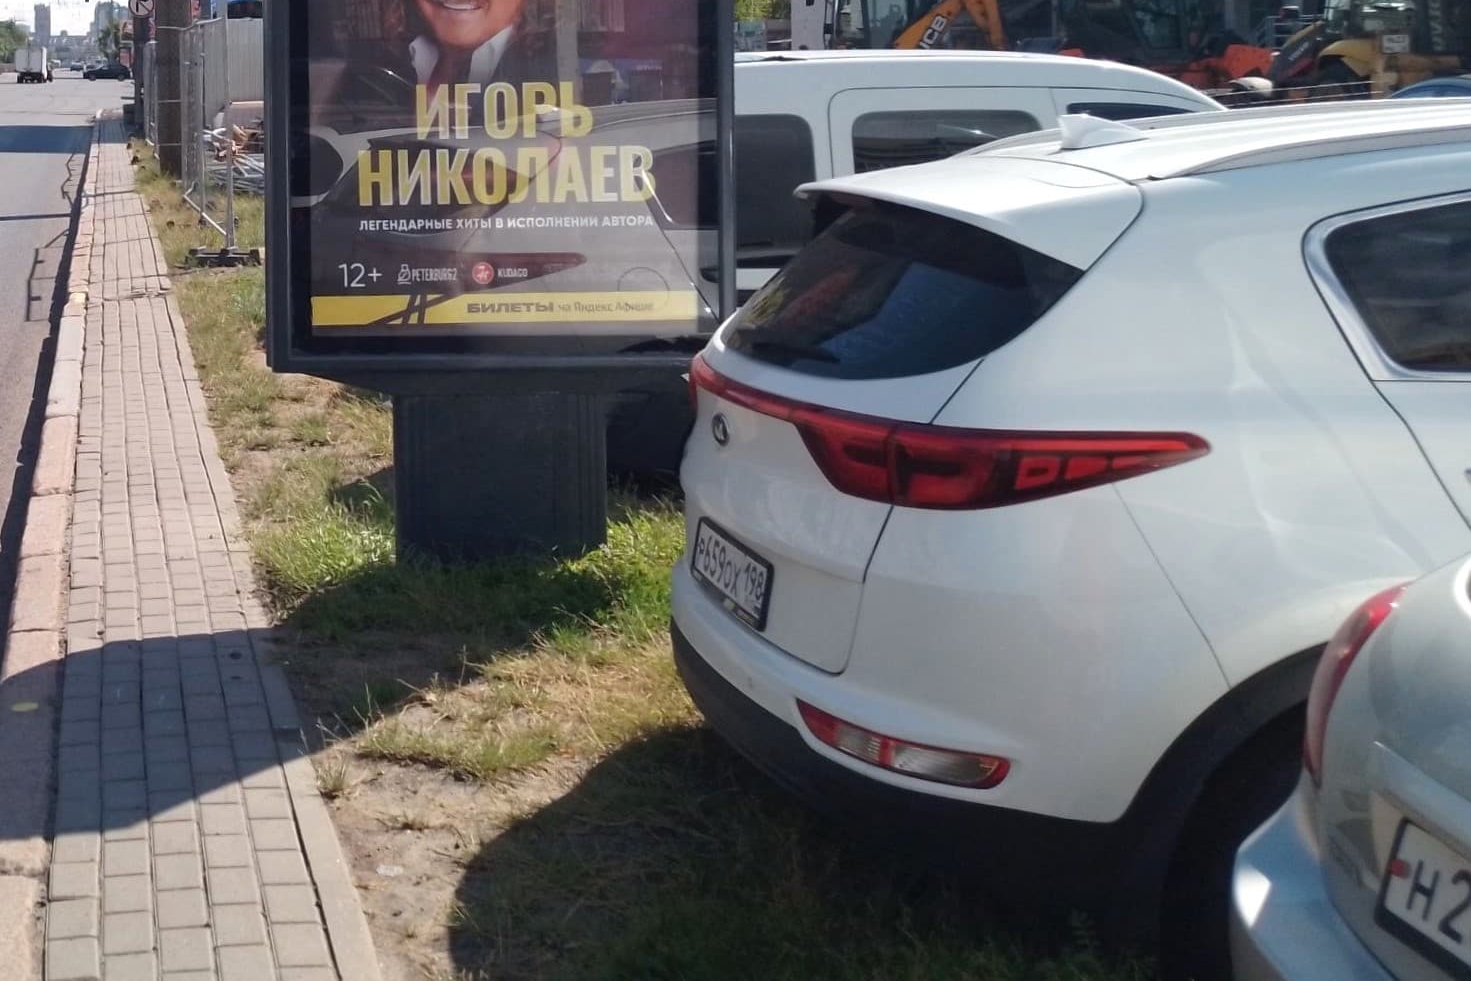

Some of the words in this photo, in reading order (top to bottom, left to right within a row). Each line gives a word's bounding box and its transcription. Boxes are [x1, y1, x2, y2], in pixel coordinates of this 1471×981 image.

[416, 82, 593, 140] ИГОРЬ
[358, 145, 656, 206] НИКОЛАЕВ
[359, 219, 453, 231] ЛЕГЕНДАРНЫЕ
[456, 218, 492, 229] ХИТЫ
[495, 218, 504, 229] В
[507, 216, 598, 229] ИСПОЛНЕНИИ
[601, 215, 654, 227] АВТОРА
[338, 263, 383, 288] 12+
[497, 268, 528, 278] KUDAGO
[467, 302, 554, 313] БИЛЕТЫ
